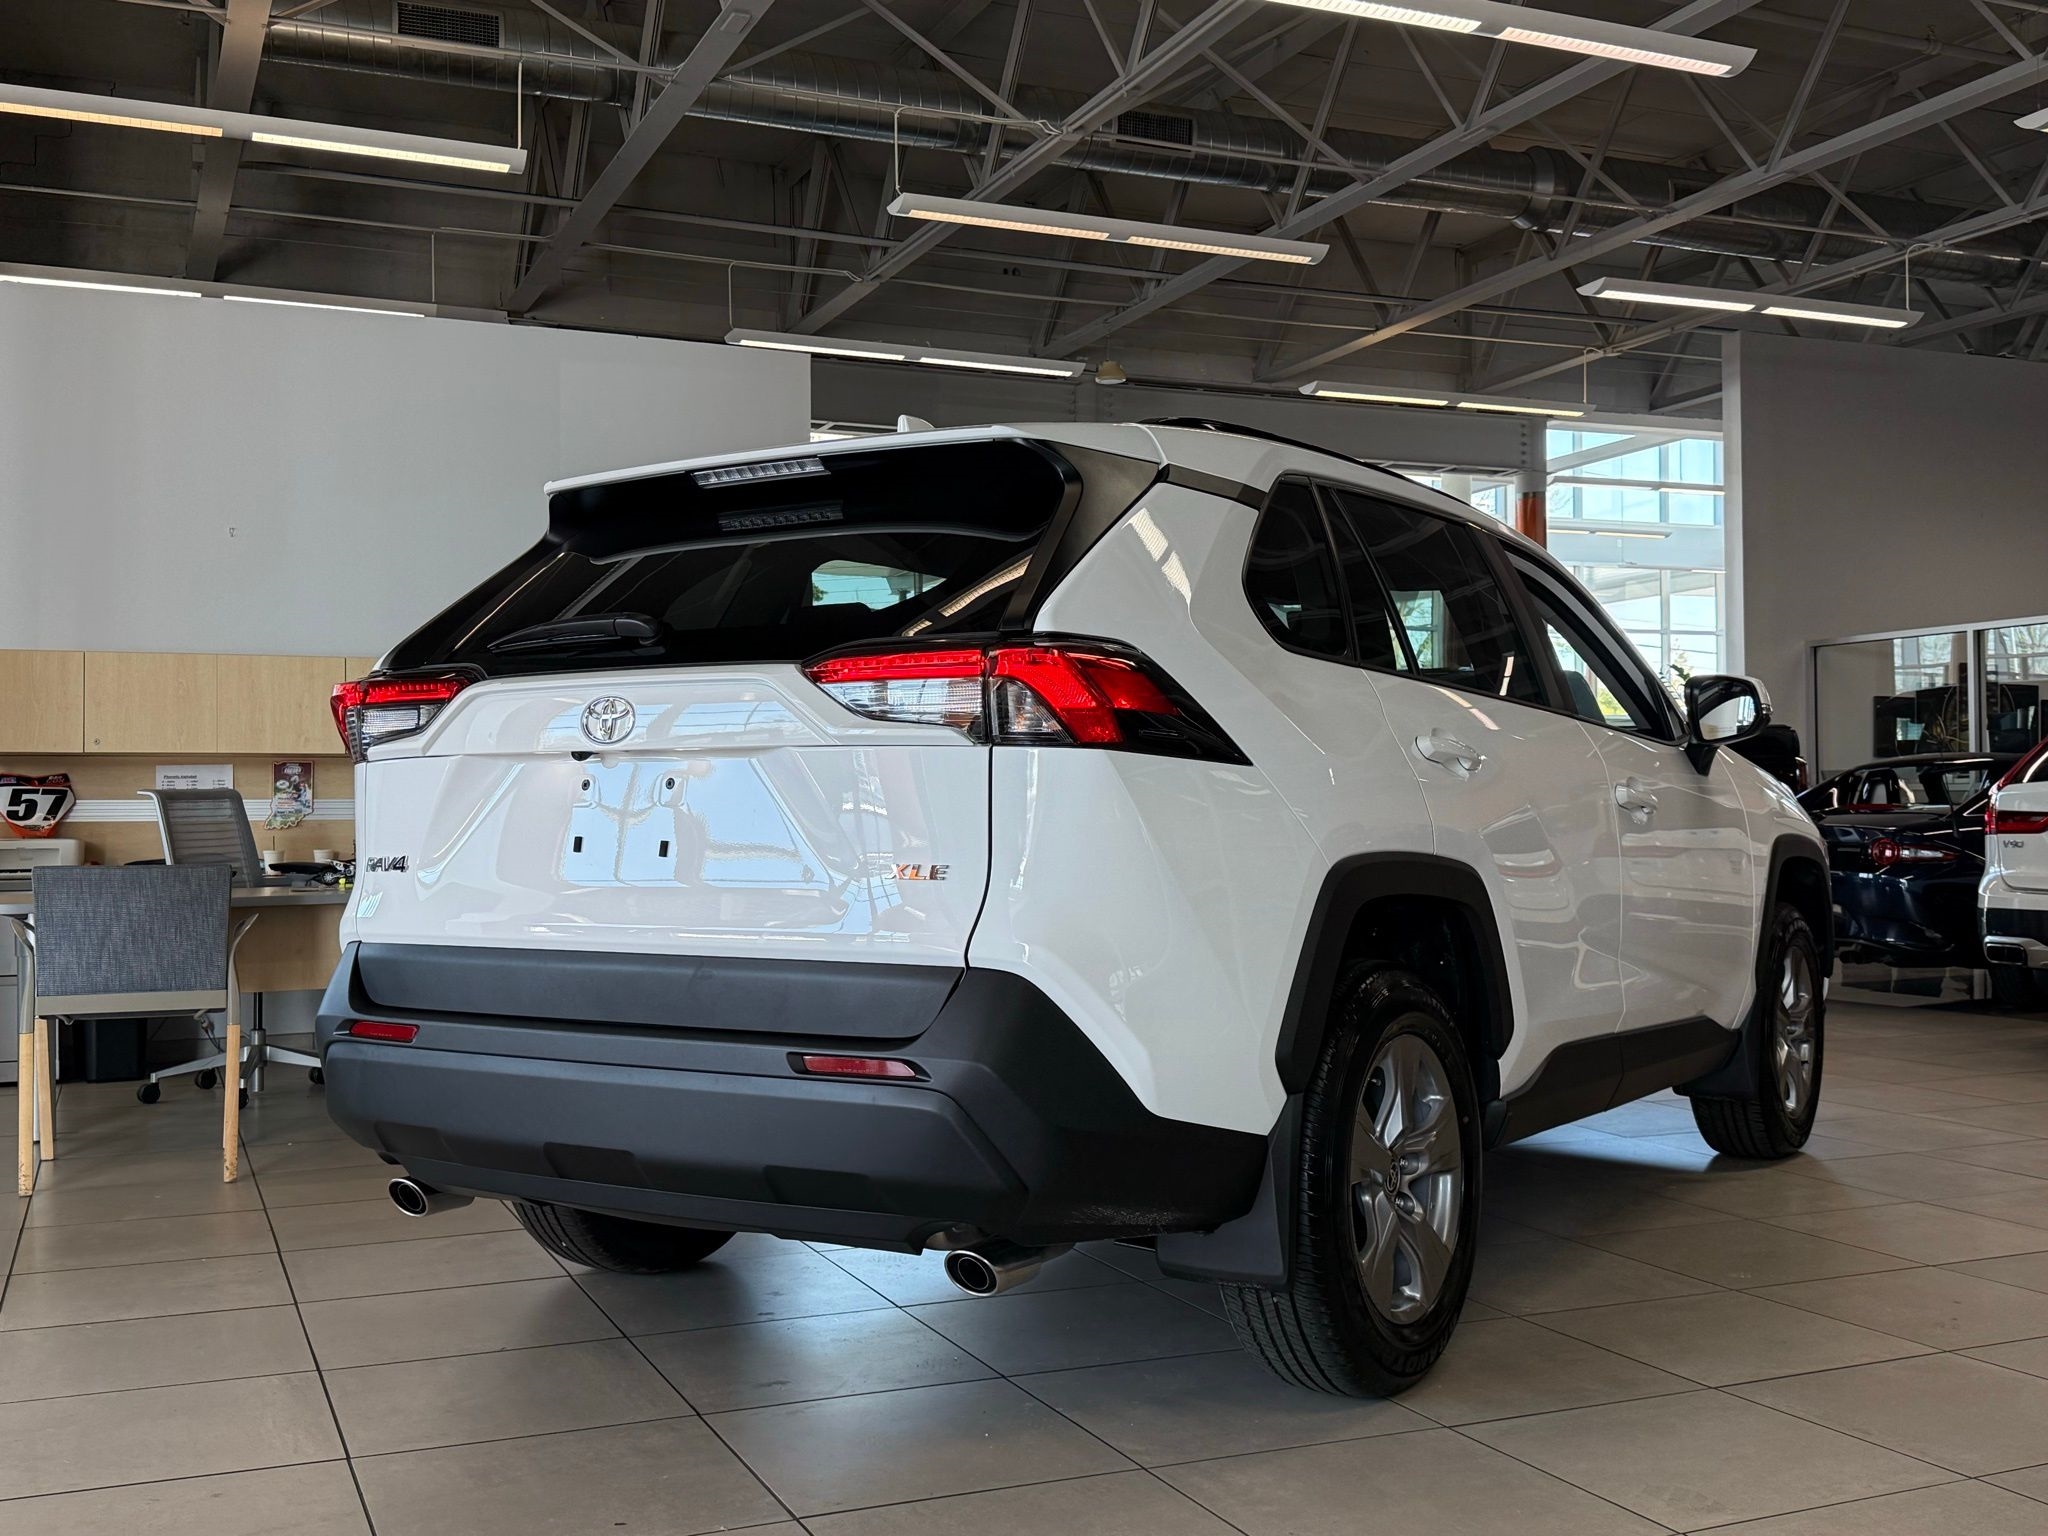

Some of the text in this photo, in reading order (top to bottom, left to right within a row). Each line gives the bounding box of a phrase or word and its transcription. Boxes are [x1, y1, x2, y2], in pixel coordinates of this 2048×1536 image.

[6, 788, 69, 822] 57
[366, 856, 409, 873] RAV4
[884, 863, 950, 881] XLE
